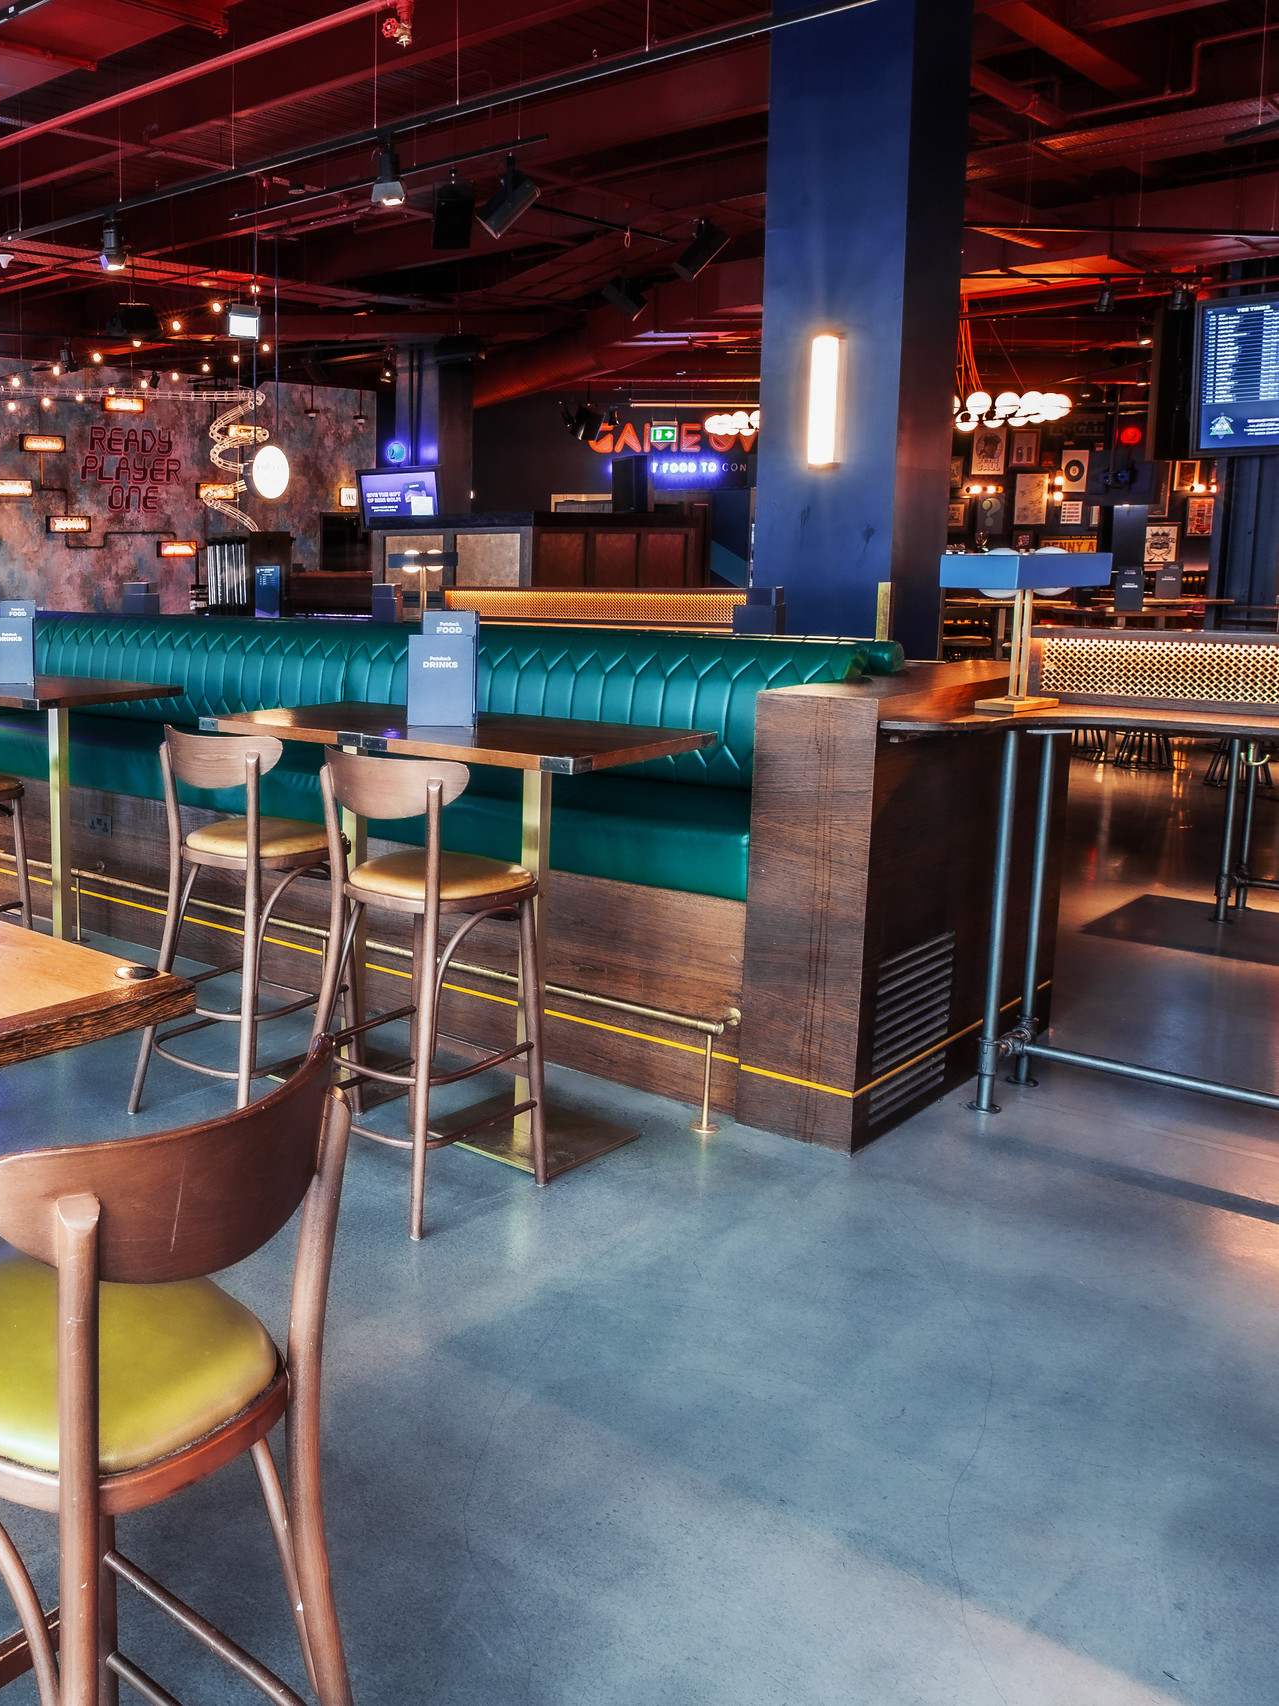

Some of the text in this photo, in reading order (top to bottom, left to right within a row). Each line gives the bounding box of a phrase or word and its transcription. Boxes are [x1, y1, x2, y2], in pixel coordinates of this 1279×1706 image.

[89, 425, 174, 457] READY
[1128, 431, 1136, 442] 2
[80, 454, 182, 485] PLAYER
[662, 462, 696, 473] FOOD
[700, 462, 717, 473] TO
[108, 485, 160, 513] ONE
